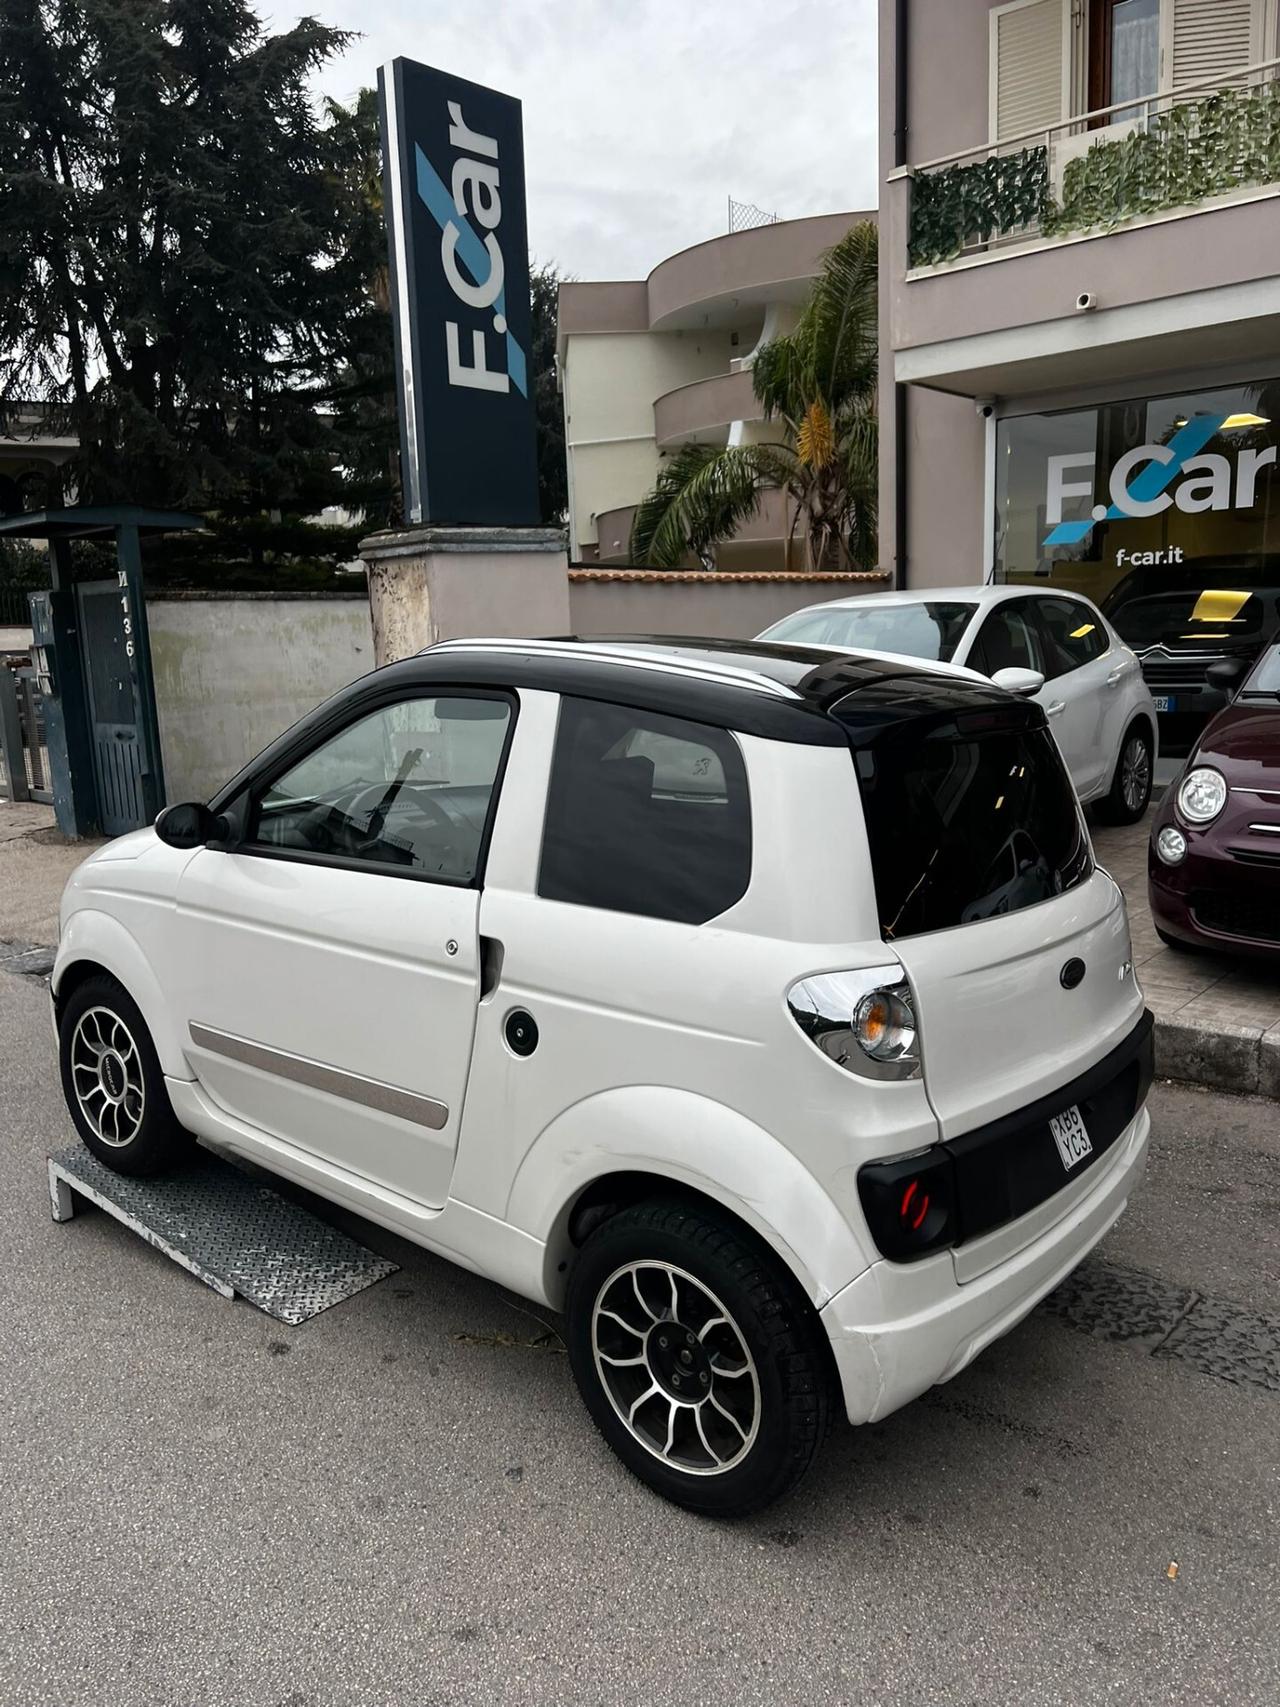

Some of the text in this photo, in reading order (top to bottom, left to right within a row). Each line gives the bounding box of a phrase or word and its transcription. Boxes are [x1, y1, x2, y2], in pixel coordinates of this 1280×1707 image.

[441, 100, 510, 393] F.Car
[1045, 444, 1277, 525] F.Car
[1115, 545, 1183, 567] f-car.it
[1063, 1128, 1088, 1161] YC3
